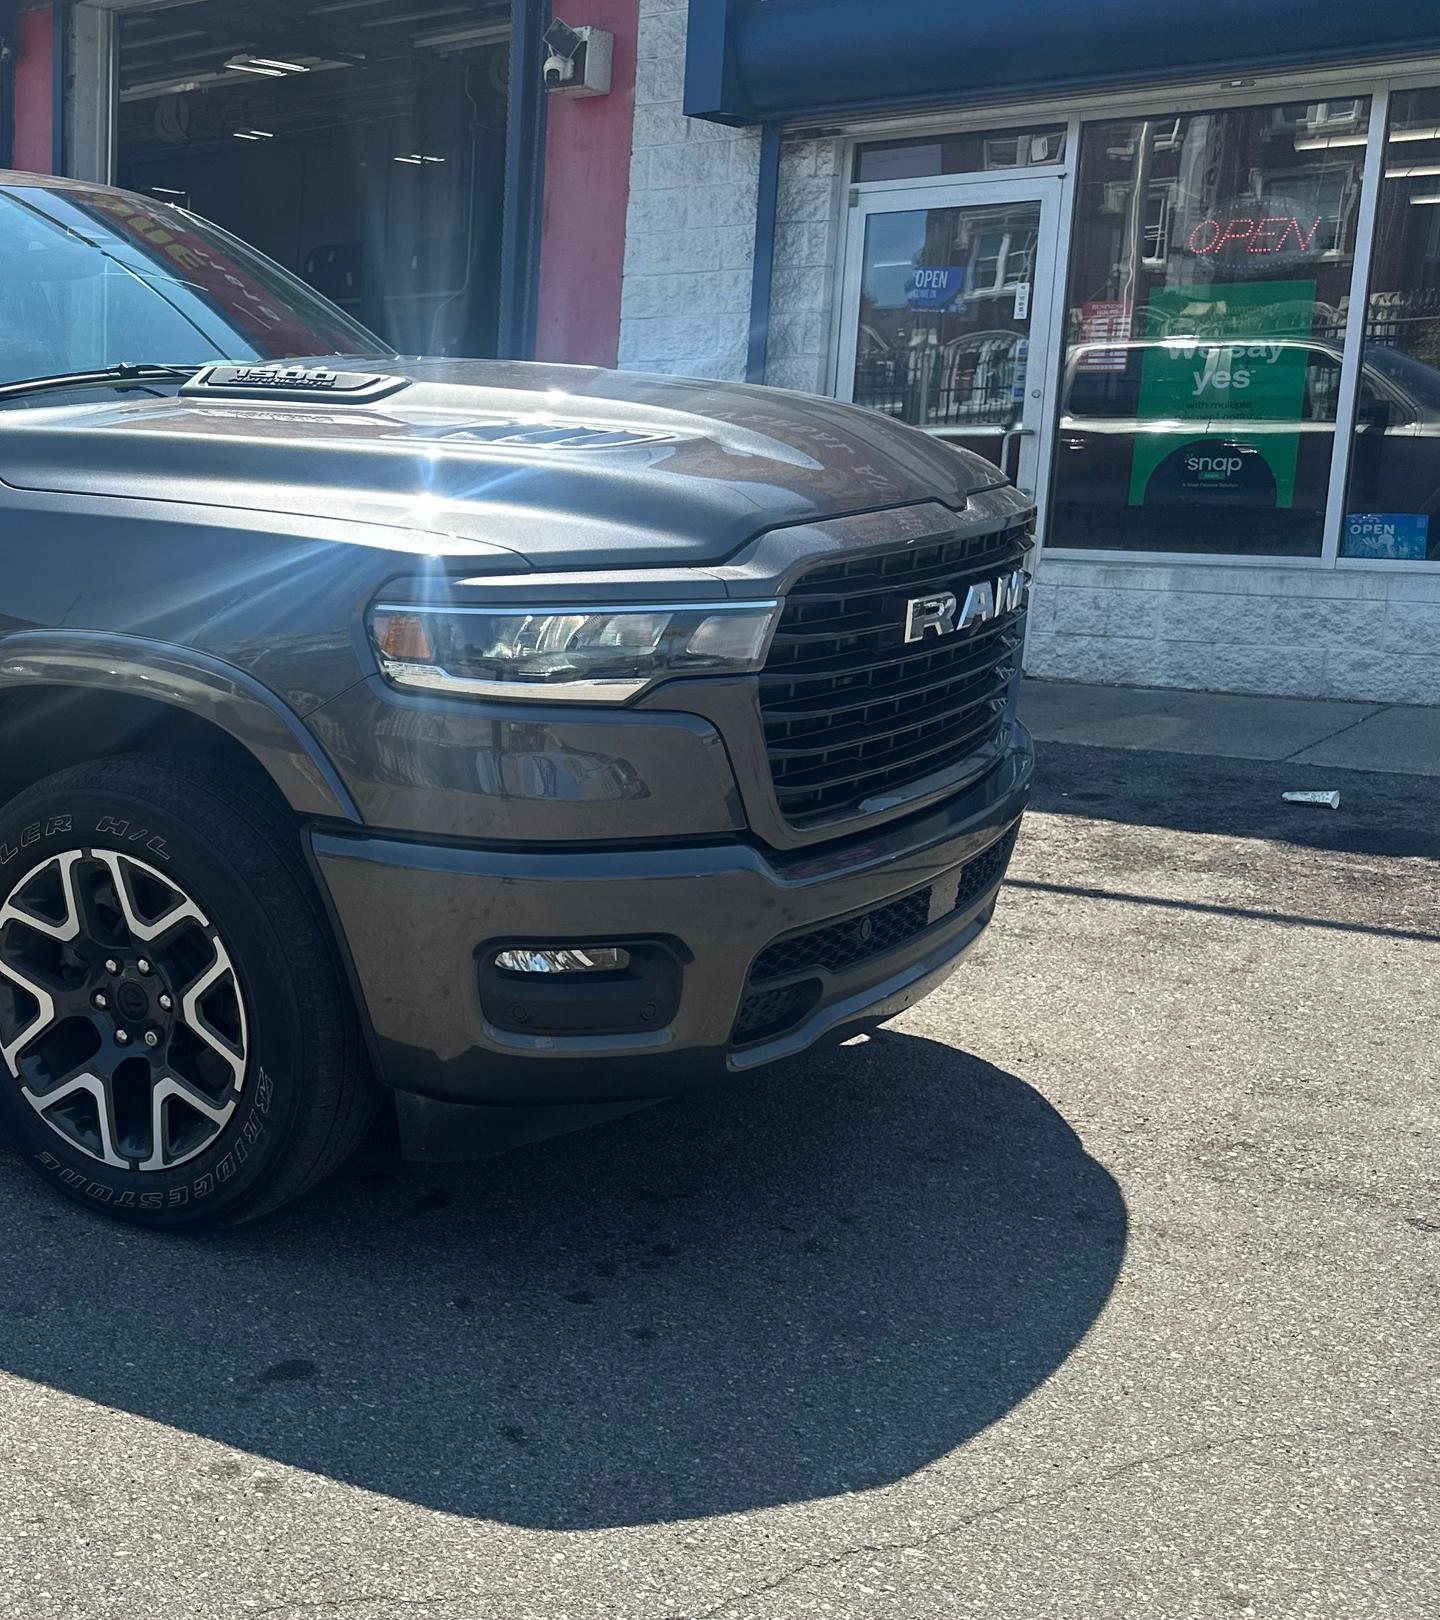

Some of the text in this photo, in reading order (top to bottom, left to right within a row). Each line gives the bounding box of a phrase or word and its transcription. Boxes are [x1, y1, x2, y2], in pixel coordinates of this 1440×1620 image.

[1189, 215, 1322, 254] OPEN
[915, 270, 948, 288] OPEN
[1192, 370, 1251, 396] yes
[1186, 400, 1252, 412] with multiple
[1187, 457, 1242, 476] snap
[1350, 524, 1395, 535] OPEN
[904, 568, 1032, 644] RAM
[96, 816, 170, 860] H/L
[35, 1066, 274, 1209] BRIDGESTONE
